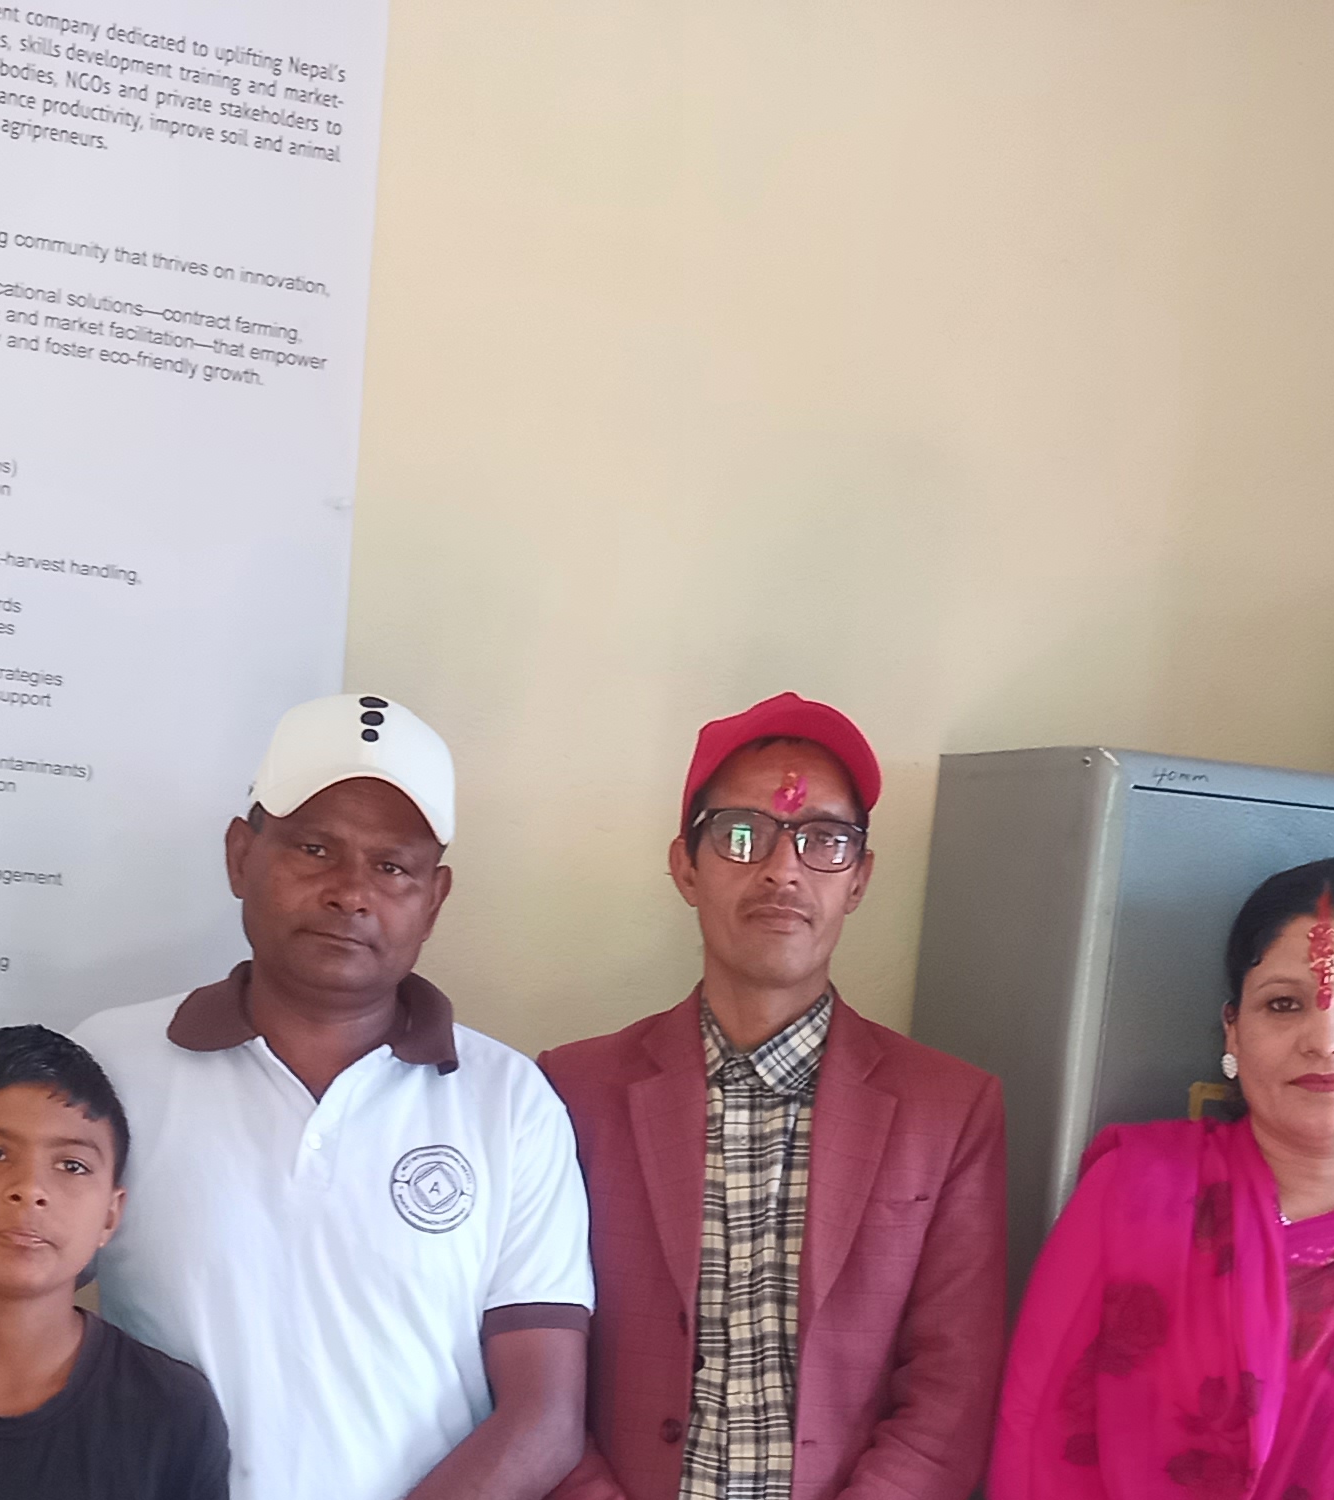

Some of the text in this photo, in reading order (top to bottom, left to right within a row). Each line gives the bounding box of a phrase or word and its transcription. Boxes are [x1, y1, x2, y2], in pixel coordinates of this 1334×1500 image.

[20, 35, 60, 57] skills
[65, 43, 172, 78] development
[180, 67, 241, 95] training
[248, 80, 277, 96] and
[26, 12, 100, 41] company
[106, 23, 185, 52] dedicated
[193, 41, 208, 56] to
[215, 46, 282, 75] uplifting
[66, 71, 111, 94] NGOs
[118, 85, 148, 101] and
[156, 90, 211, 112] private
[219, 102, 318, 131] stakeholders
[326, 121, 341, 135] to
[150, 113, 214, 140] improve
[220, 129, 248, 146] soil
[254, 136, 282, 151] and
[288, 141, 340, 162] animal
[14, 234, 109, 262] community
[115, 247, 147, 266] that
[153, 253, 208, 275] thrives
[213, 266, 234, 279] on
[6, 310, 38, 325] and
[45, 316, 103, 335] market
[249, 348, 327, 369] empower
[7, 336, 39, 350] and
[45, 338, 94, 358] foster
[99, 350, 198, 378] eco-friendly
